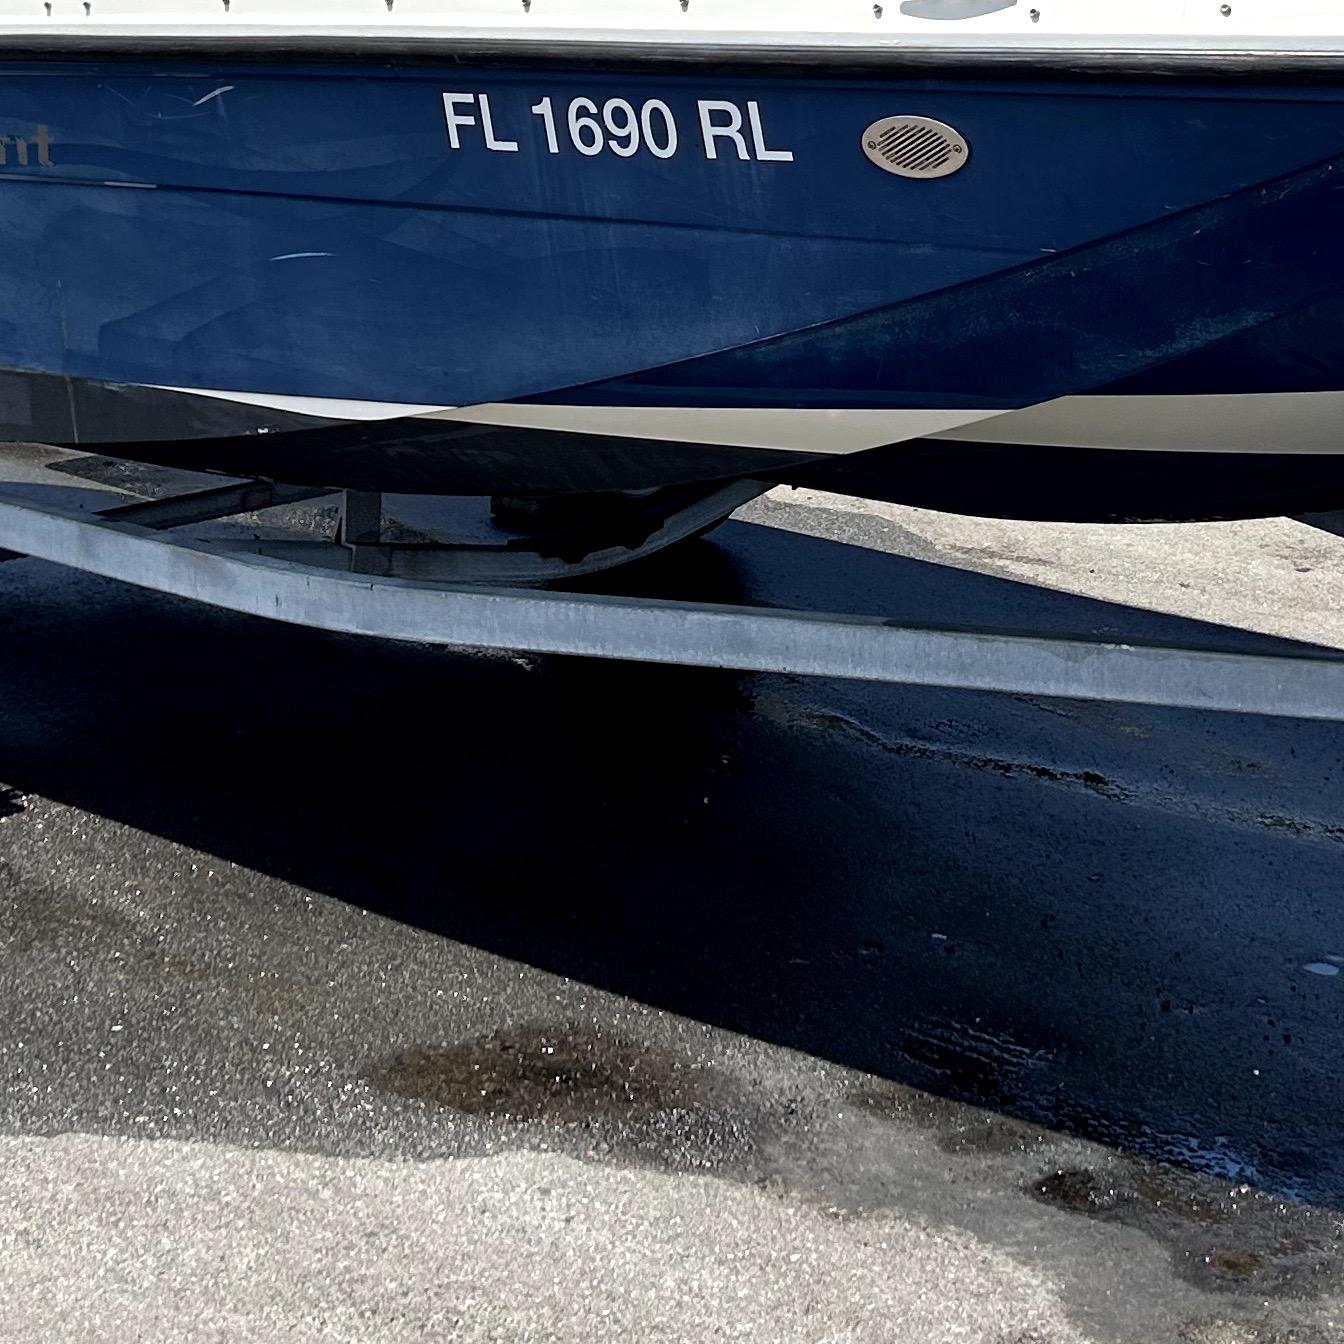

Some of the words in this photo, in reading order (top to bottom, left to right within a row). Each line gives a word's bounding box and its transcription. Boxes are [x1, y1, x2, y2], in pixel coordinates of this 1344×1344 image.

[442, 92, 518, 152] FL
[531, 96, 677, 159] 1690
[698, 100, 794, 163] RL
